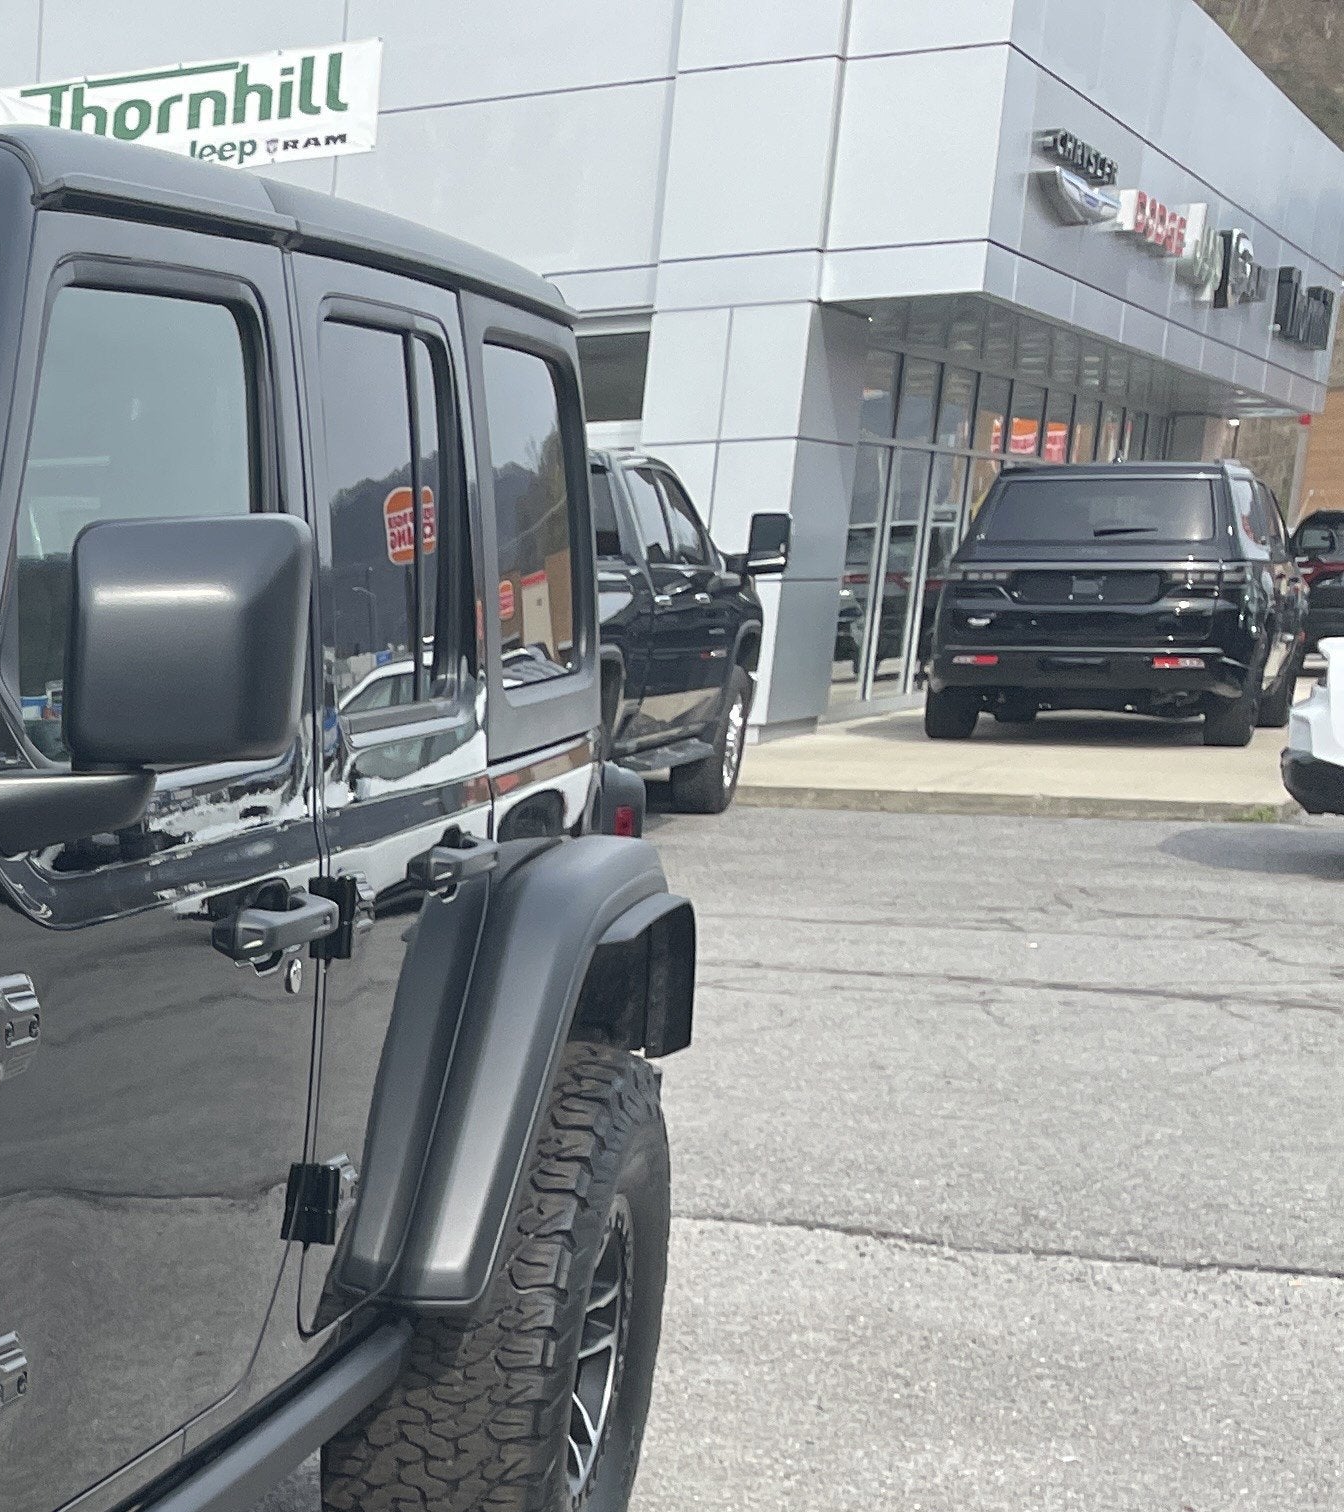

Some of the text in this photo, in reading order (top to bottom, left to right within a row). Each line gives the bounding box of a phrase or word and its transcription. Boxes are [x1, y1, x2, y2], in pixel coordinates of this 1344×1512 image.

[21, 53, 348, 140] Thornhill
[189, 134, 347, 165] Jeep RAM
